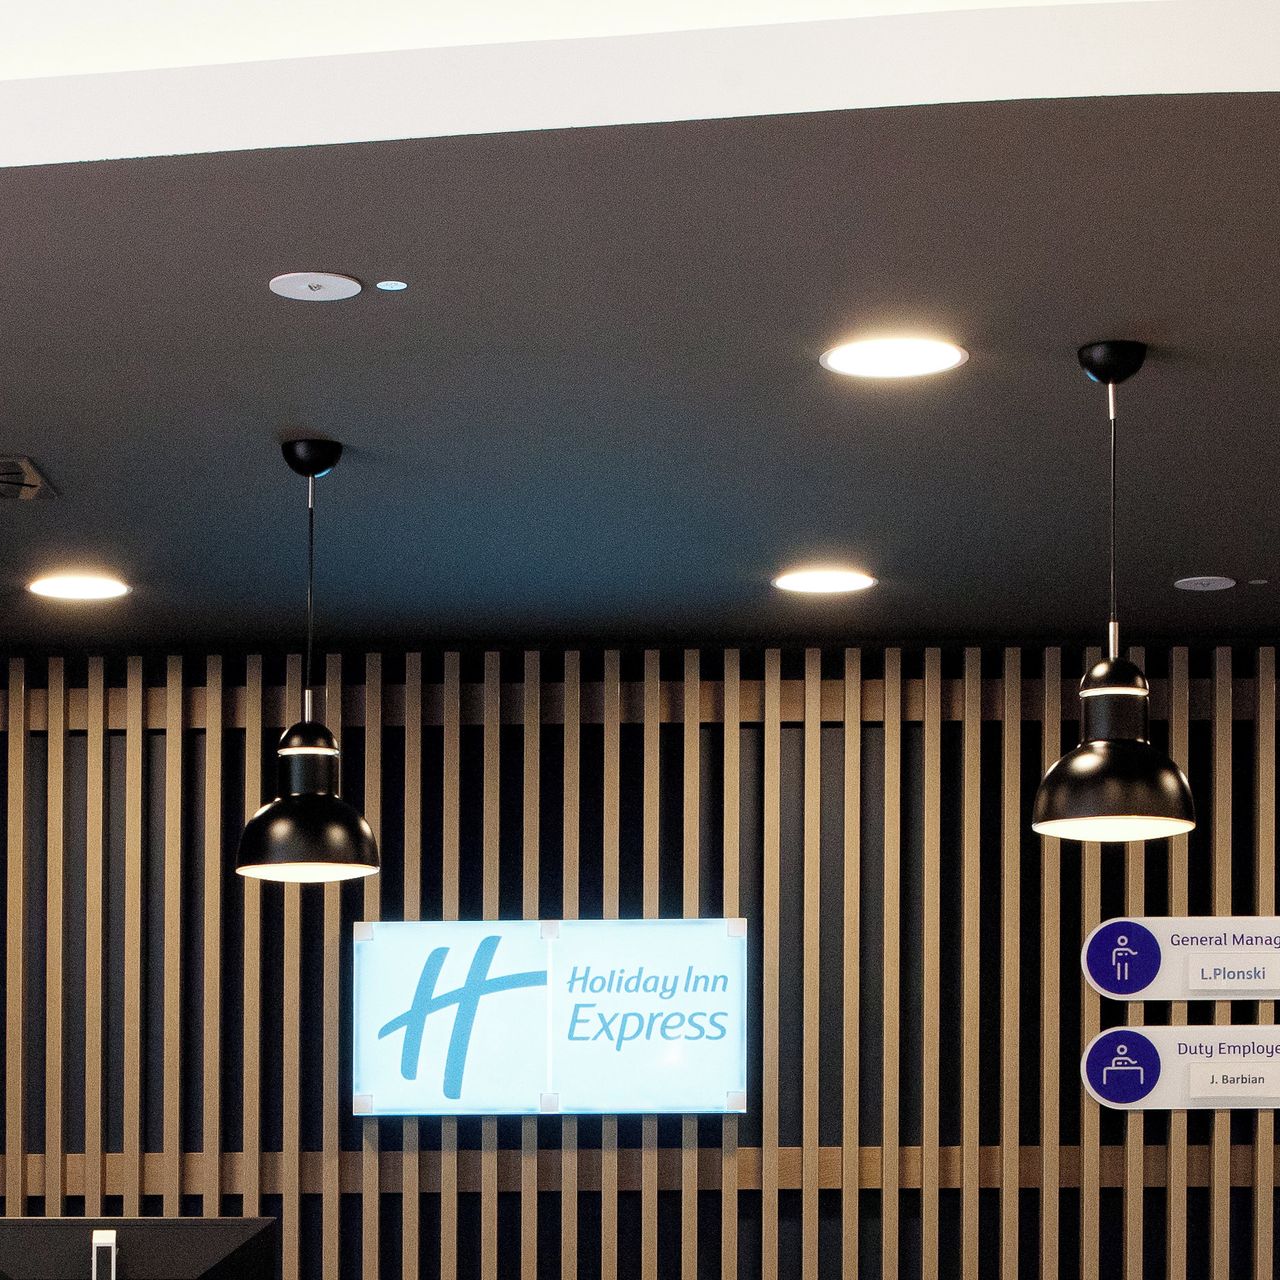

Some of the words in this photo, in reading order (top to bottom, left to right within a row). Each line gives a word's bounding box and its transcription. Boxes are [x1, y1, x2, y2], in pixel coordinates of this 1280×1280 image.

[1170, 933, 1228, 946] General
[1200, 967, 1266, 980] L.Plonski
[567, 965, 681, 999] Holiday
[684, 966, 729, 993] Inn
[567, 1003, 729, 1051] Express
[1177, 1042, 1213, 1058] Duty
[1210, 1074, 1218, 1085] J.
[1221, 1074, 1265, 1085] Barbian
